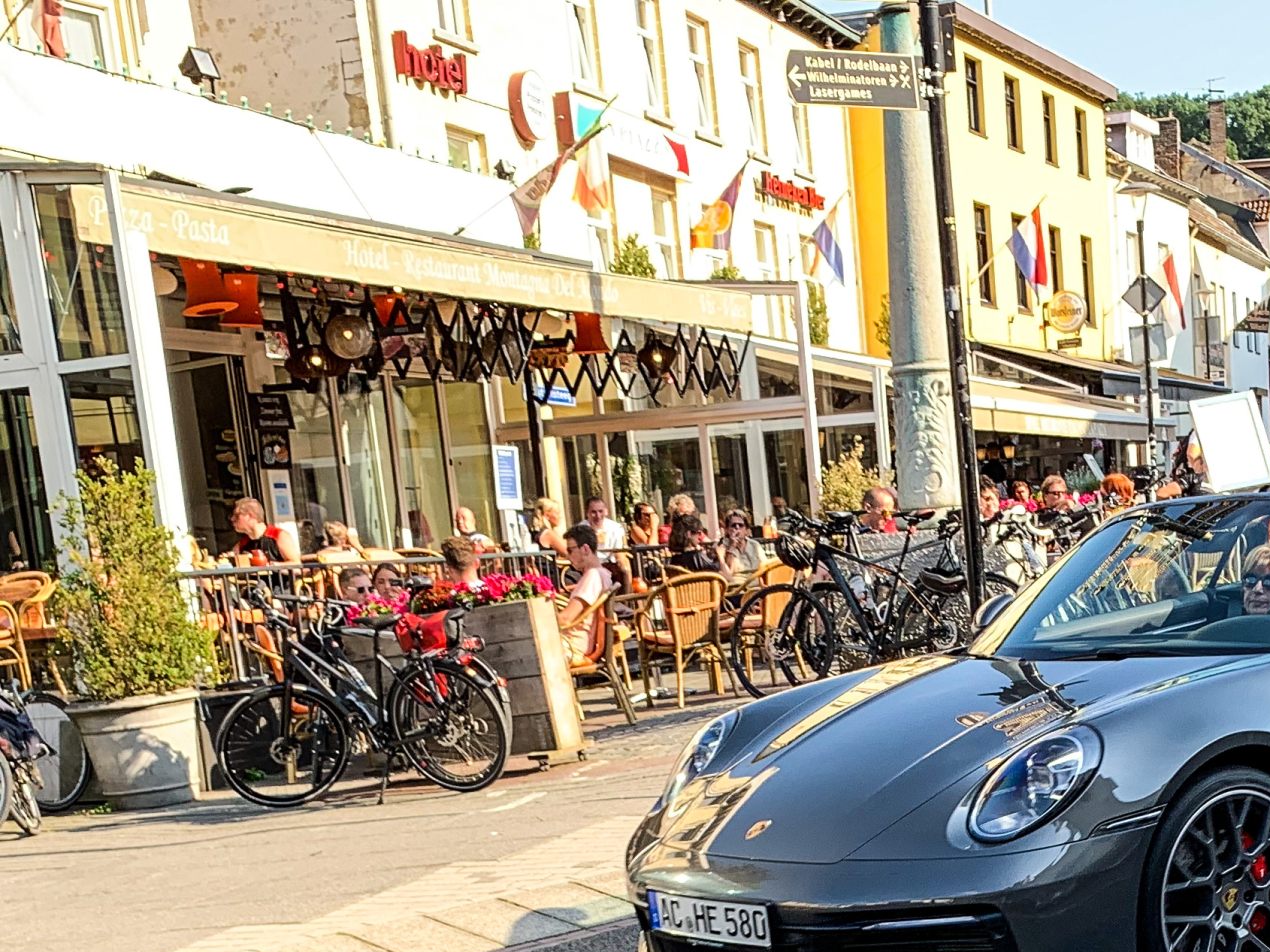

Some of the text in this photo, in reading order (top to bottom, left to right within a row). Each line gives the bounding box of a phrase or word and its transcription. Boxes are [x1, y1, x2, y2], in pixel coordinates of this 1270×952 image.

[391, 30, 467, 95] hotel
[805, 56, 835, 69] Kabel
[844, 58, 897, 72] Rodelbaan
[807, 71, 887, 86] Wilhelminatoren
[809, 86, 872, 100] Lasergames
[88, 195, 154, 233] Pza
[171, 209, 230, 245] Pasta
[344, 239, 390, 270] Hotel
[402, 250, 481, 281] Restaurant
[483, 262, 550, 299] Montagna
[661, 898, 766, 940] AC HE 580
